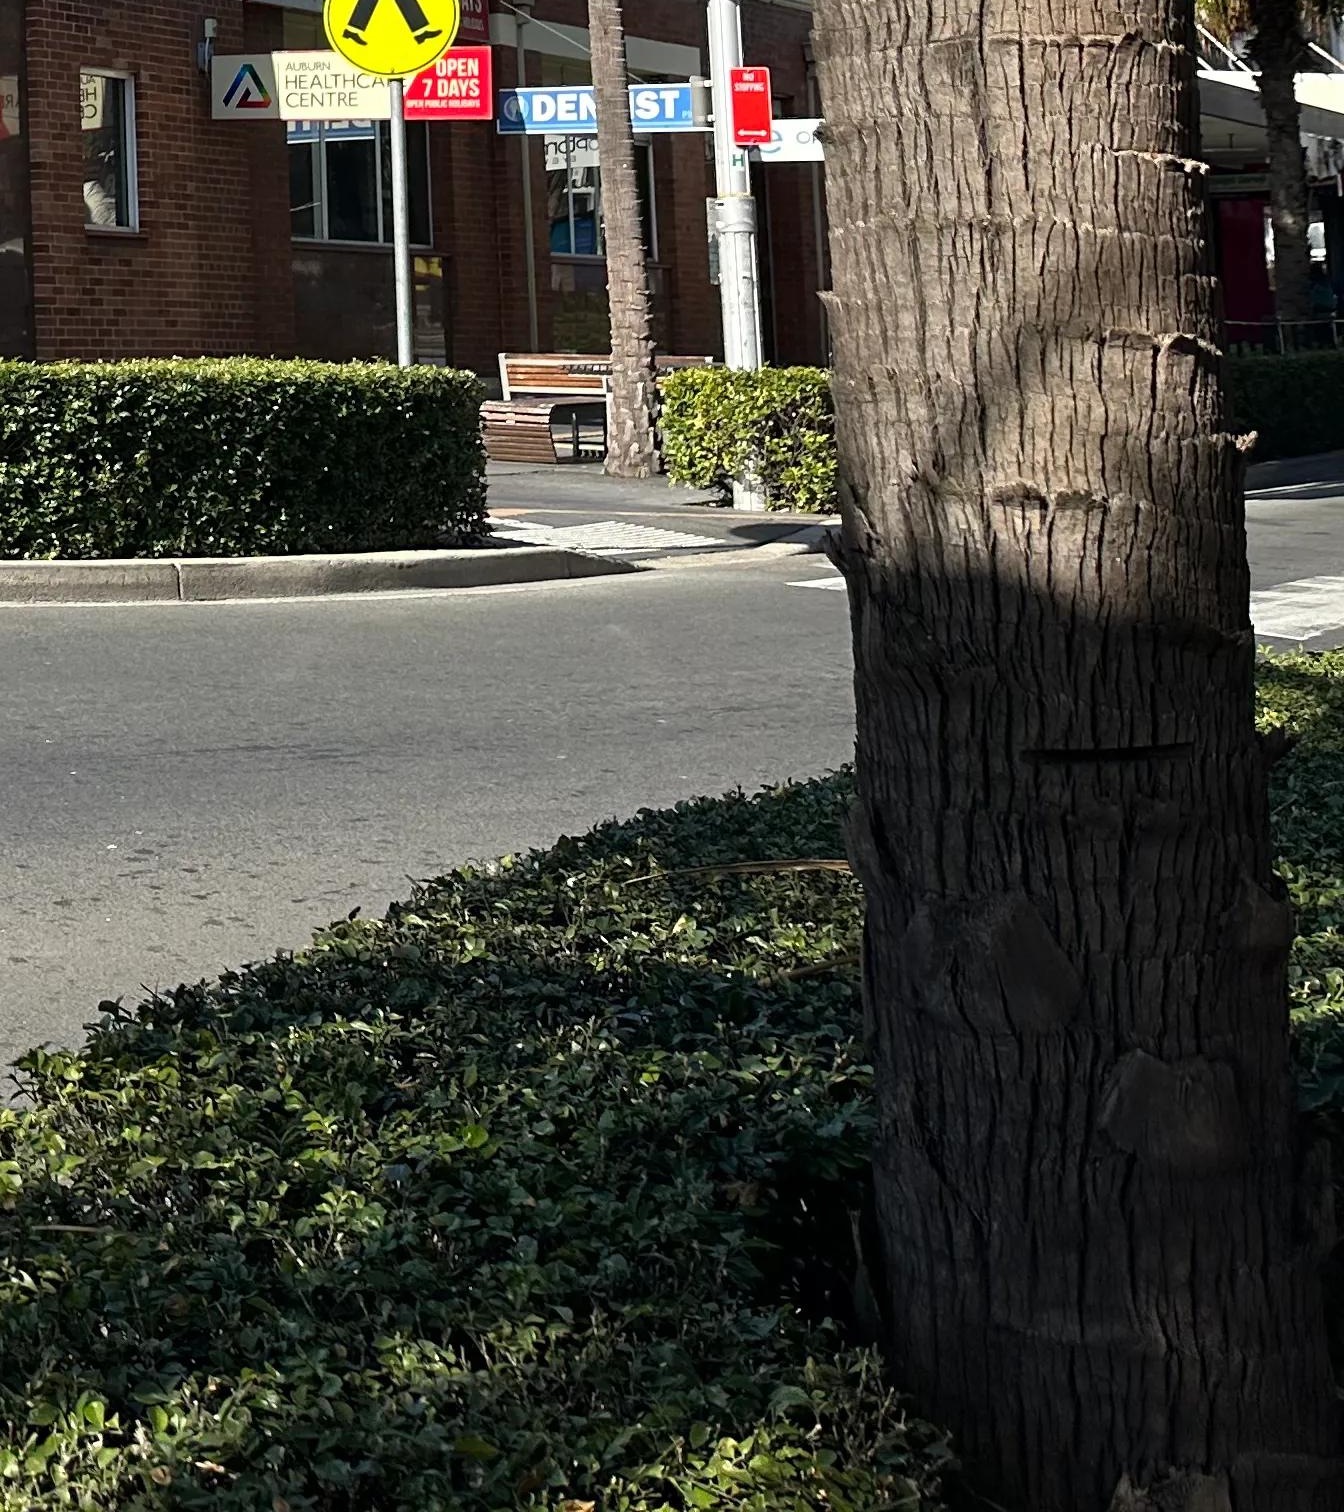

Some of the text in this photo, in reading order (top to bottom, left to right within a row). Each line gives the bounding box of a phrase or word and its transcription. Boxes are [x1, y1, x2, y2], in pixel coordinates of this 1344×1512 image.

[285, 61, 331, 72] AUBURN
[435, 58, 479, 77] OPEN
[285, 72, 407, 90] HEALTHCA
[743, 73, 754, 81] NO
[422, 78, 480, 97] 7 DAYS
[734, 82, 764, 92] STOPPING
[285, 91, 359, 108] CENTRE
[531, 90, 680, 122] DENST
[732, 153, 744, 167] H
